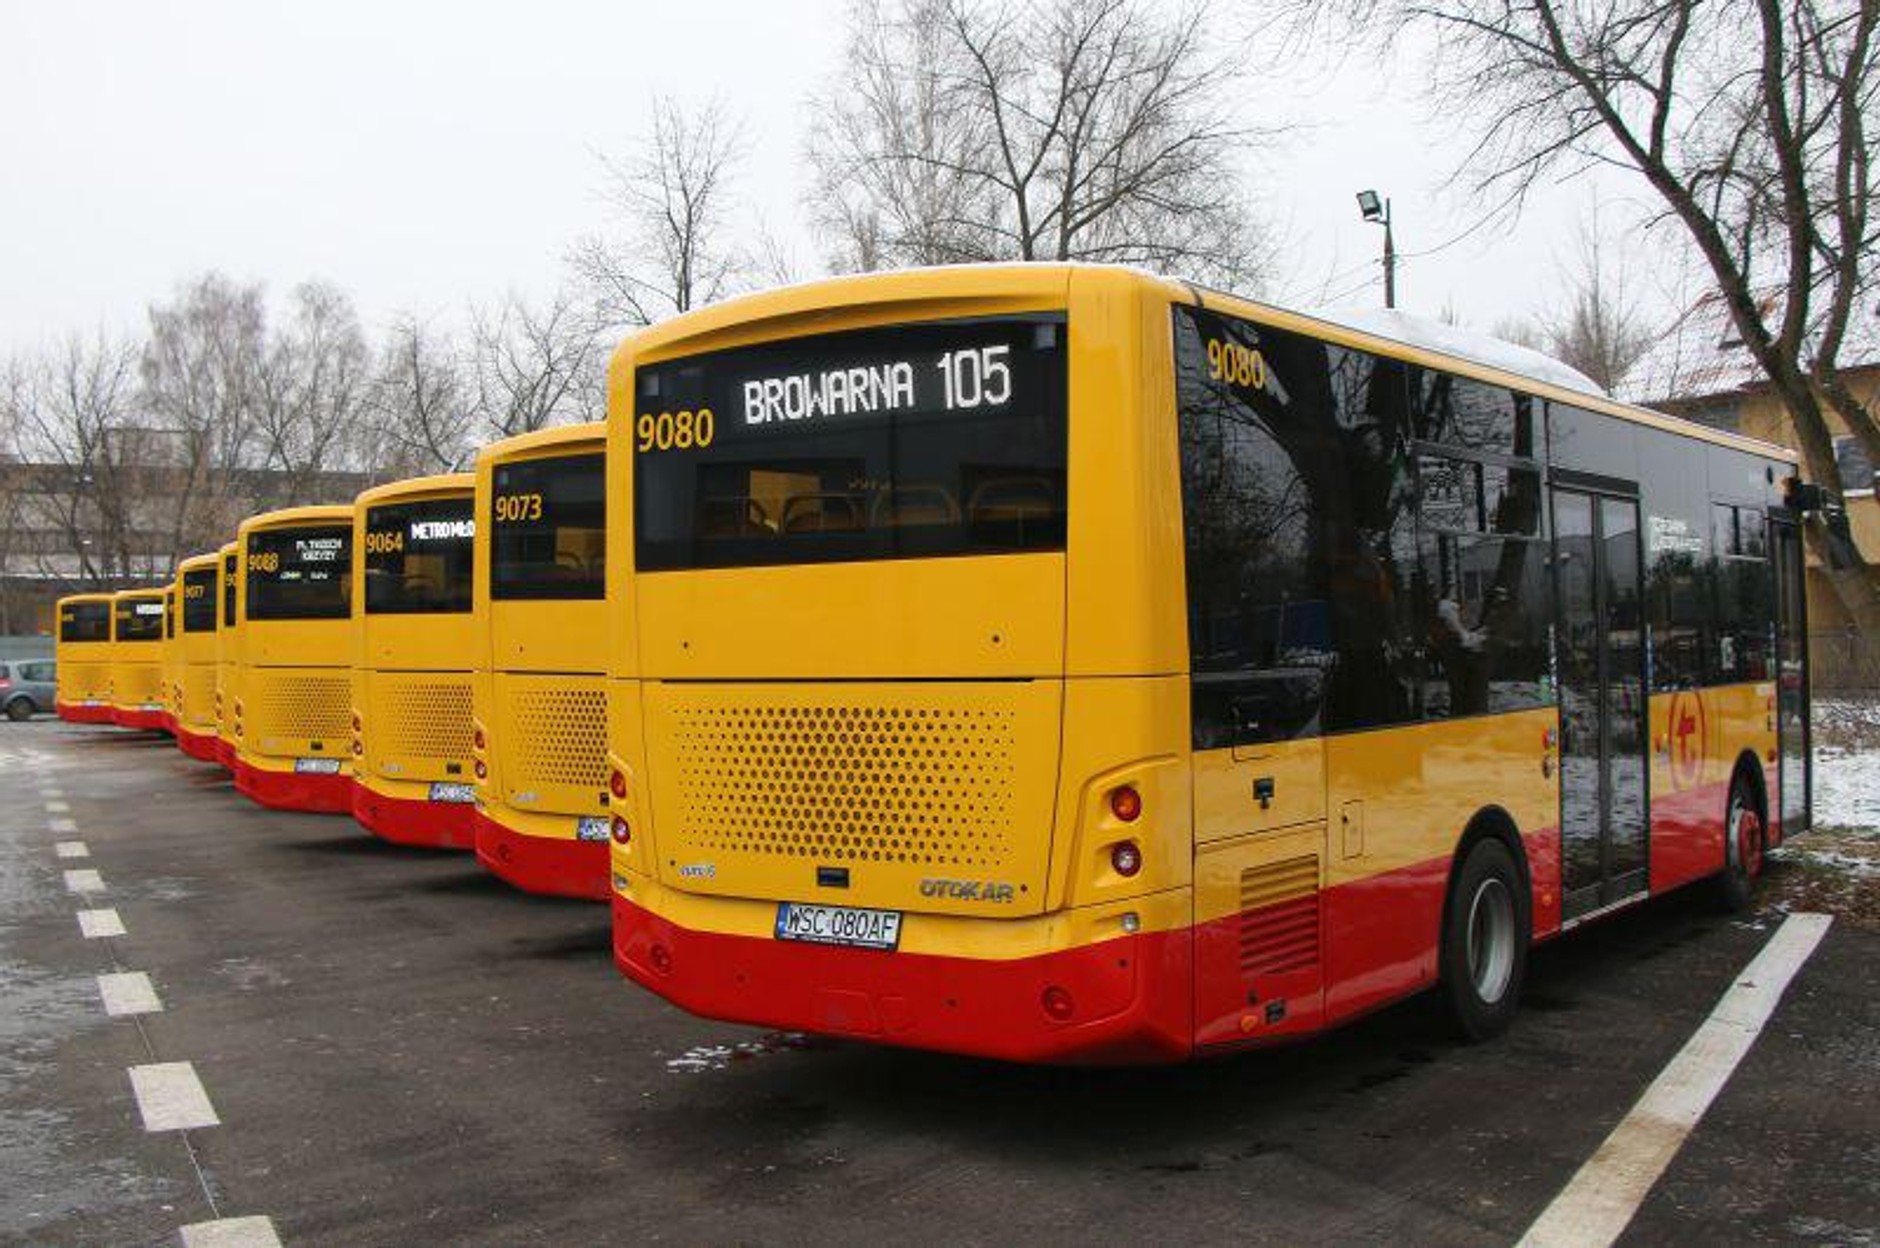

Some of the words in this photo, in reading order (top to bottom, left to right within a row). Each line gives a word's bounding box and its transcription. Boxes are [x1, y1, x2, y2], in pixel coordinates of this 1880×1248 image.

[1207, 338, 1267, 390] 9080
[743, 361, 915, 425] BROWARNA
[937, 344, 1012, 410] 105
[637, 408, 714, 452] 9080
[495, 493, 542, 521] 9073
[366, 531, 403, 553] 9064
[411, 522, 450, 540] METRO
[919, 879, 1014, 903] OTOKAR
[788, 906, 825, 934] WSC
[832, 909, 896, 939] 080AF
